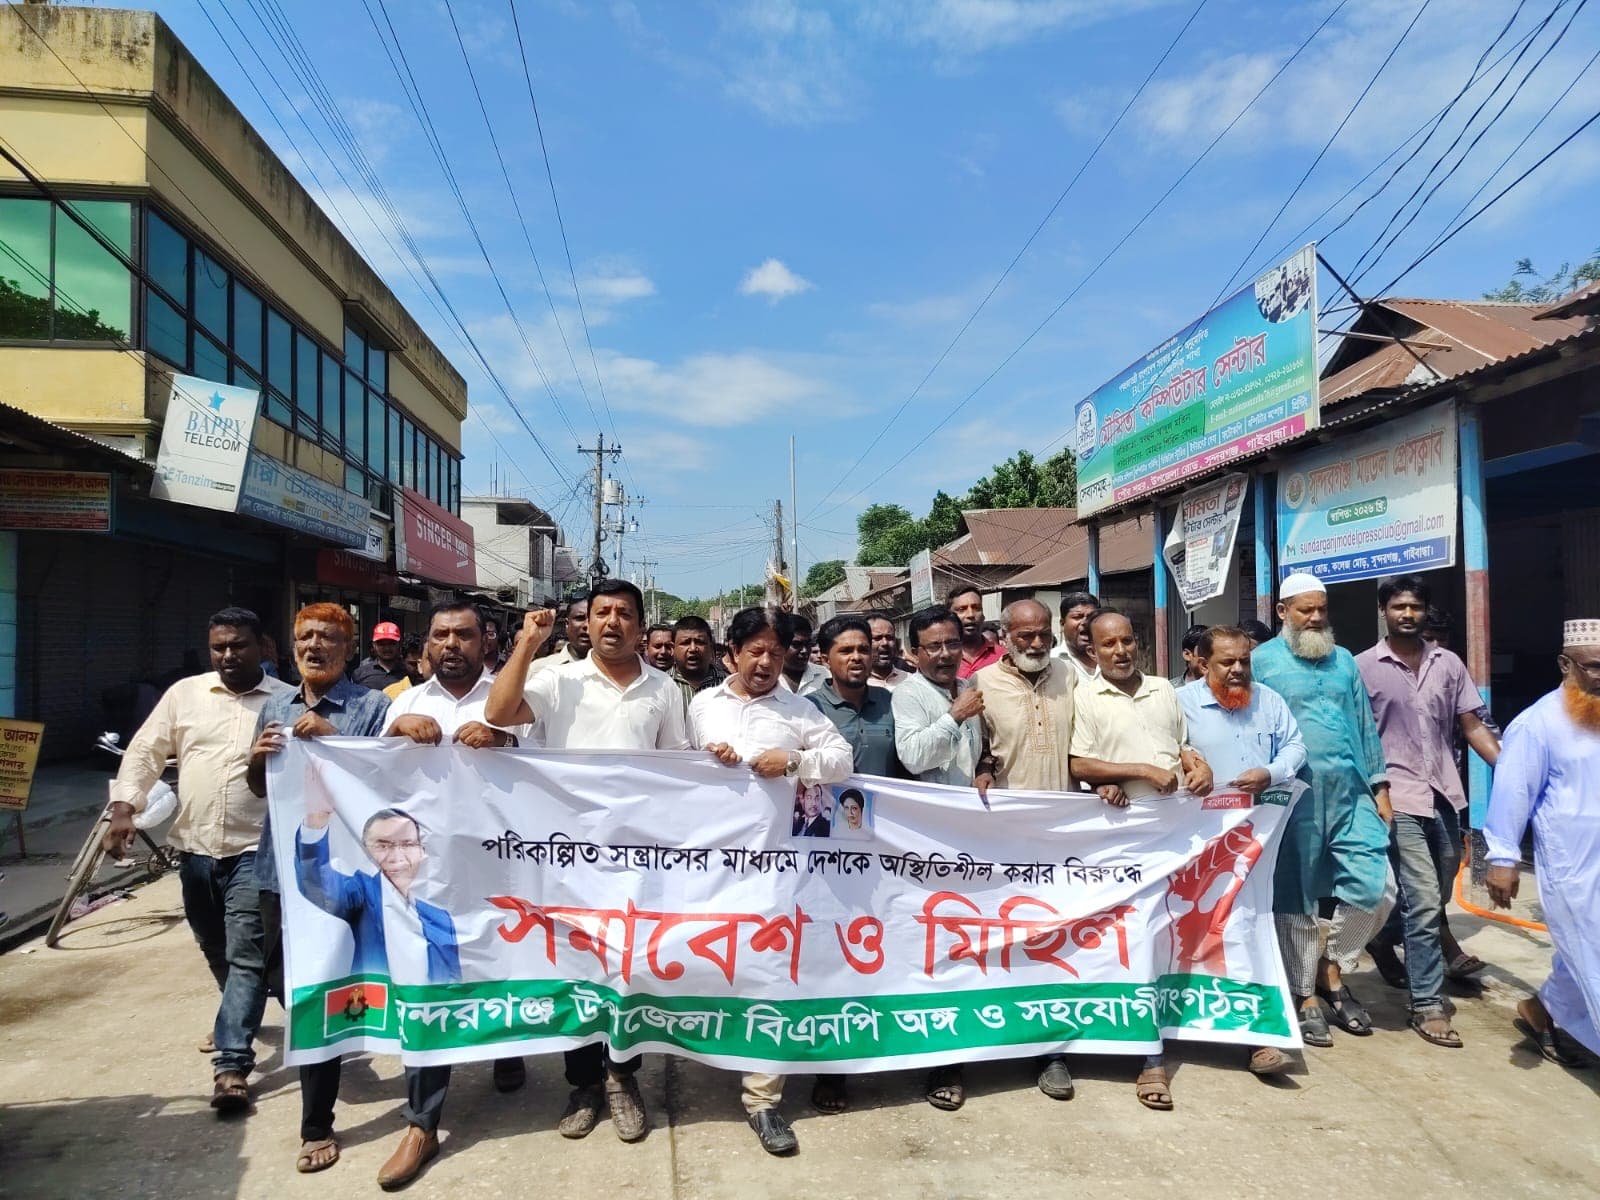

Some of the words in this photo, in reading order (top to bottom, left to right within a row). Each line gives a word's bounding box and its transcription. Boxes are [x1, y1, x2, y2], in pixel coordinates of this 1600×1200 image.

[1139, 366, 1208, 420] কম্পিউটার
[1212, 333, 1268, 388] সেন্টার
[184, 431, 241, 452] TELECOM
[187, 410, 246, 440] BAPPY
[416, 512, 453, 552] SINGER
[1300, 512, 1445, 555] sundarganjmodelpressclub@gmail.com
[482, 829, 601, 868] পরিকল্পিত
[607, 843, 713, 872] সন্ত্রাসের
[720, 845, 799, 874] মাধ্যমে
[807, 848, 873, 875] দেশকে
[879, 851, 995, 883] অস্থিতিশীল
[1000, 860, 1055, 885] করার
[1063, 855, 1144, 886] বিরুদ্ধে
[487, 896, 813, 986] সমাবেশ
[835, 915, 885, 975] ও
[912, 890, 1138, 979] মিছিল
[742, 1001, 883, 1046] বিএনপি
[890, 1006, 961, 1039] অঙ্গ
[973, 1004, 1006, 1029] ও
